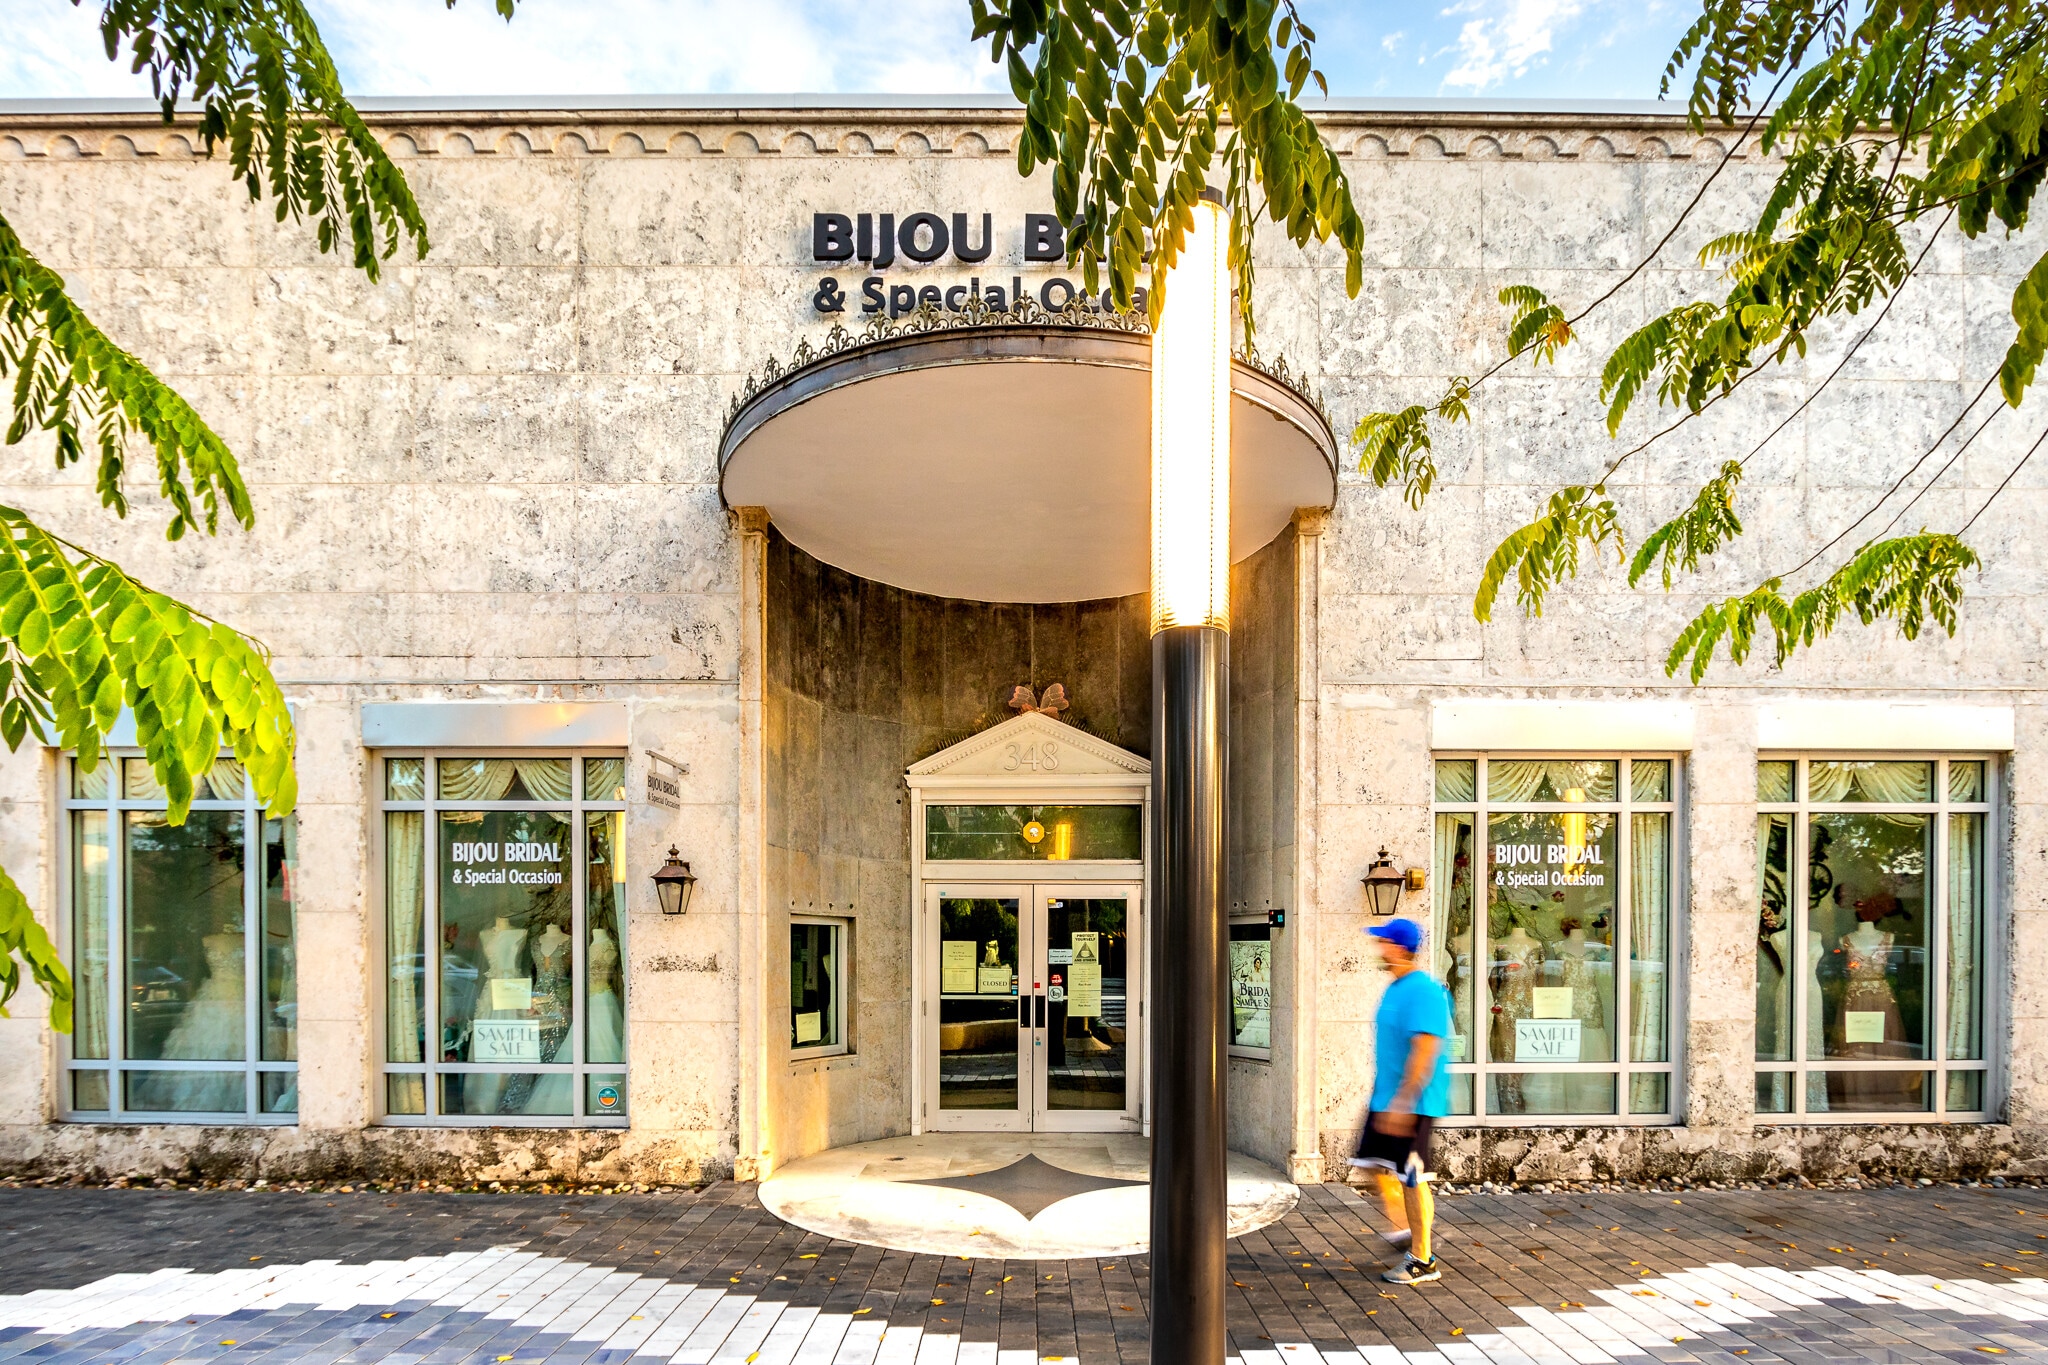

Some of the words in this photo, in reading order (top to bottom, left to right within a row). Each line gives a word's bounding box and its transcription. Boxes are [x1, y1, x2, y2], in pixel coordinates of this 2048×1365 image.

[813, 213, 992, 269] BIJOU
[813, 277, 846, 313] &
[862, 276, 1021, 319] Special
[1004, 742, 1059, 771] 348
[648, 775, 662, 791] BIJOU
[663, 781, 680, 798] BRIDAL
[651, 793, 664, 804] Special
[665, 797, 680, 810] Occasion
[452, 842, 498, 866] BIJOU
[504, 842, 562, 863] BRIDAL
[1495, 844, 1541, 867] BIJOU
[1547, 844, 1604, 865] BRIDAL
[453, 869, 462, 884] &
[465, 868, 505, 887] Special
[509, 869, 562, 884] Occasion
[1495, 871, 1504, 886] &
[1507, 870, 1548, 888] Special
[1551, 871, 1604, 886] Occasion
[1235, 995, 1263, 1007] SAMPLE
[478, 1026, 537, 1041] SAMPLE
[1518, 1026, 1578, 1041] SAMPLE
[489, 1041, 526, 1056] SALE
[1529, 1041, 1567, 1056] SALE
